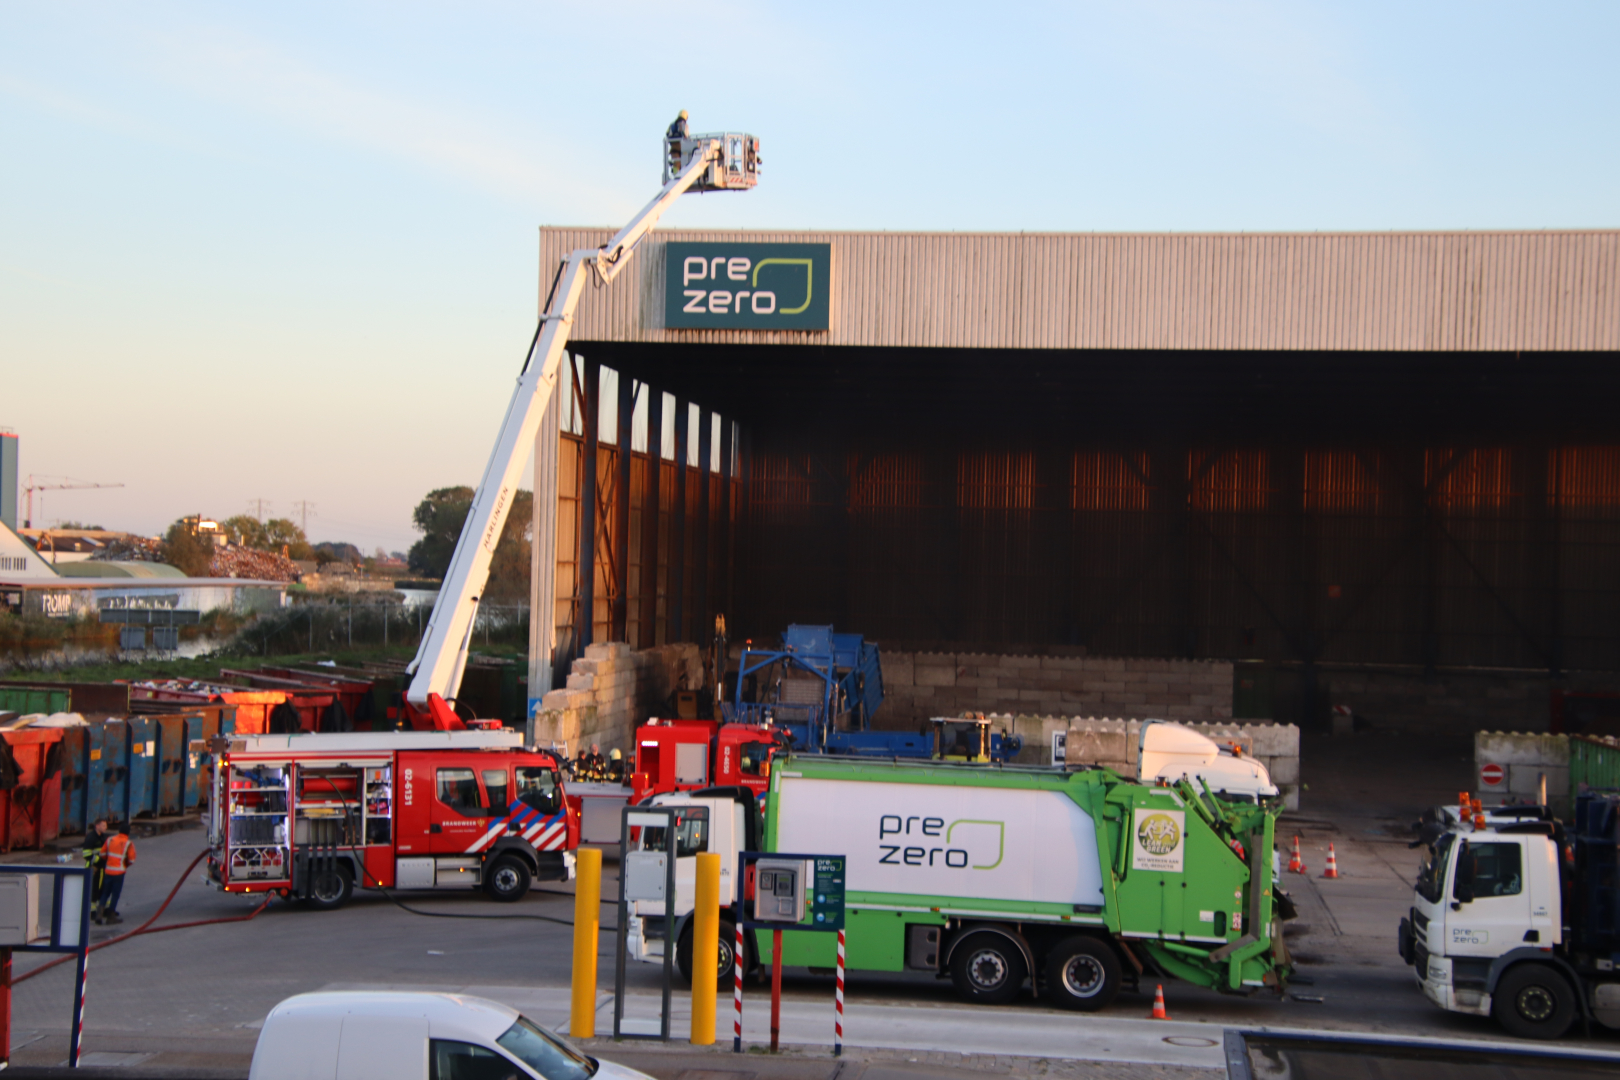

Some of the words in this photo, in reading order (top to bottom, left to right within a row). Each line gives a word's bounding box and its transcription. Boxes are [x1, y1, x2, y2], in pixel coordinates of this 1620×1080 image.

[683, 256, 751, 287] pre
[683, 290, 776, 314] zero
[484, 486, 508, 548] HARLINGEN
[404, 768, 412, 806] 02-6131
[879, 815, 944, 840] pre
[1142, 839, 1162, 847] LEAN
[817, 859, 831, 867] pre
[879, 845, 968, 868] zero
